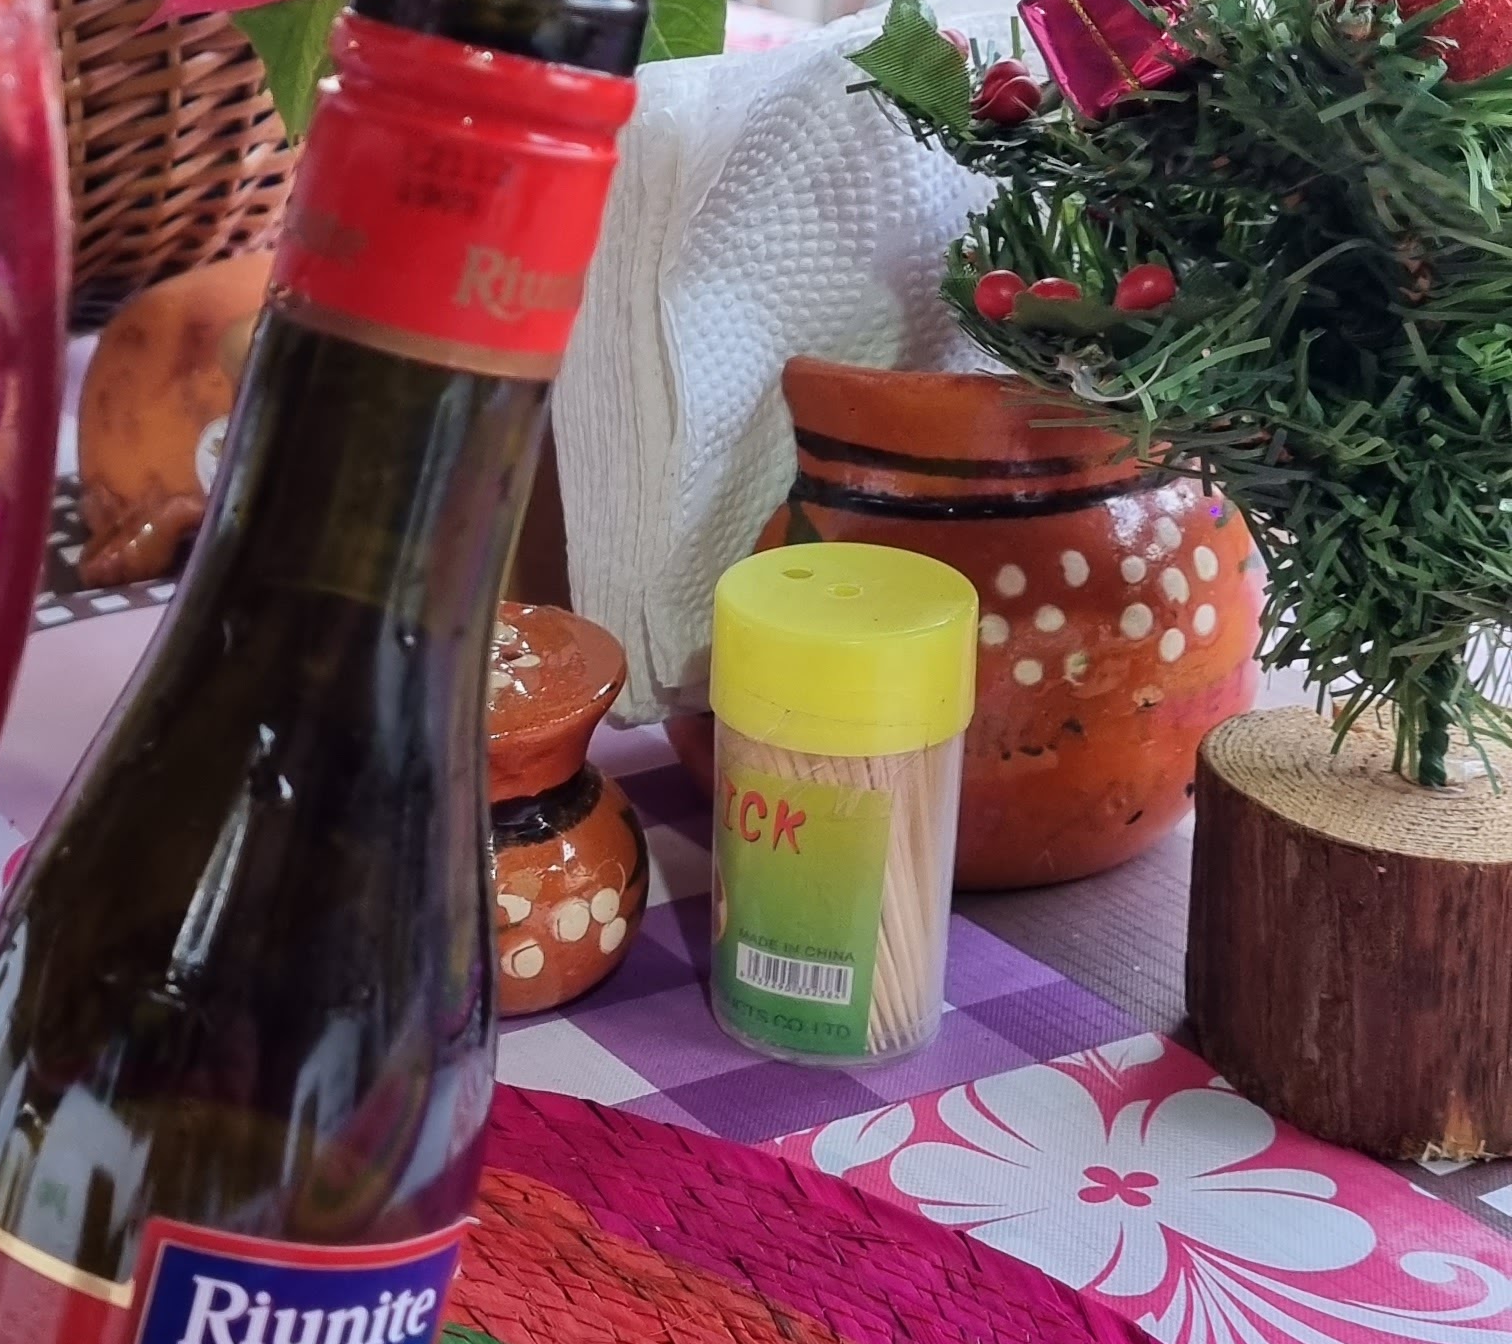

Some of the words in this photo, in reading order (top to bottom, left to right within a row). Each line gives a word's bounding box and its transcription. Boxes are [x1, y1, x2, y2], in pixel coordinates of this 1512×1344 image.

[738, 927, 778, 950] MADE
[784, 942, 800, 954] IN
[804, 945, 856, 963] CHINA
